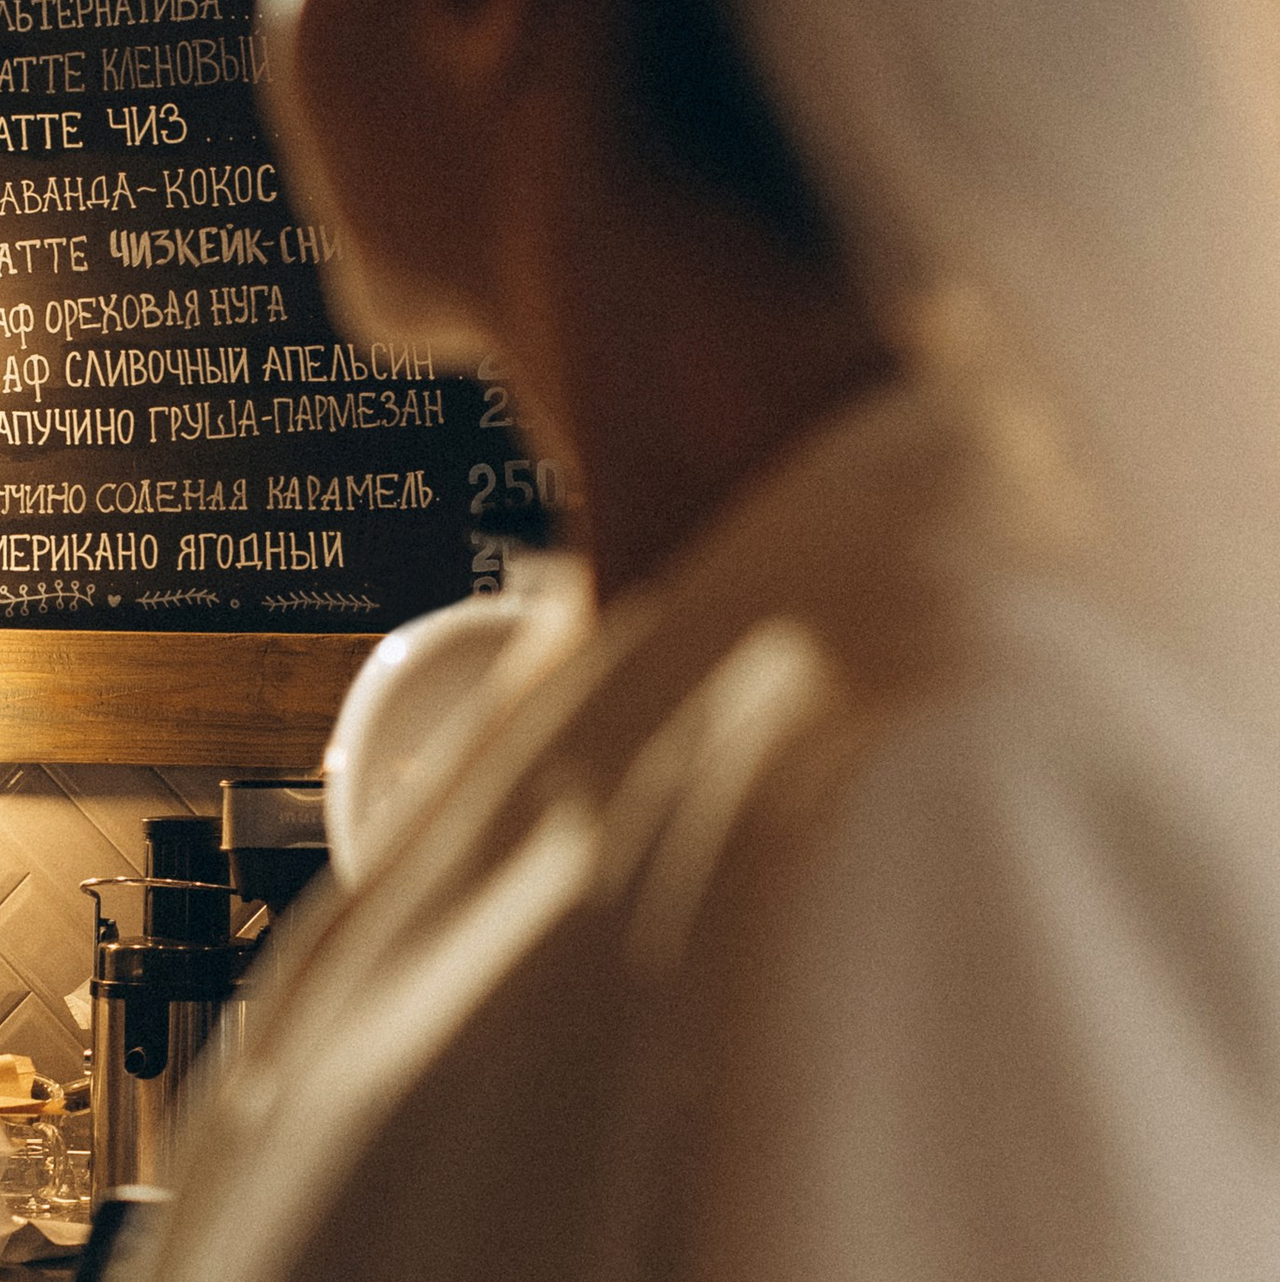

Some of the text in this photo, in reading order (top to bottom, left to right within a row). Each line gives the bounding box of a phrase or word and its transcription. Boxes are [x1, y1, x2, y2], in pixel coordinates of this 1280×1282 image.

[106, 103, 188, 146] ЧИЗ
[45, 289, 200, 340] ОРЕХОВАЯ
[210, 285, 288, 327] НУГА
[65, 347, 250, 388] СЛИВОЧНЫЙ
[262, 342, 436, 382] АПЕЛЬСИН
[148, 389, 445, 443] ГРУША-ПАРМЕЗАН
[95, 478, 249, 514] СОЛЕНАЯ
[266, 470, 434, 512] КАРАМЕЛЬ
[177, 531, 345, 571] ЯГОДНЫЙ
